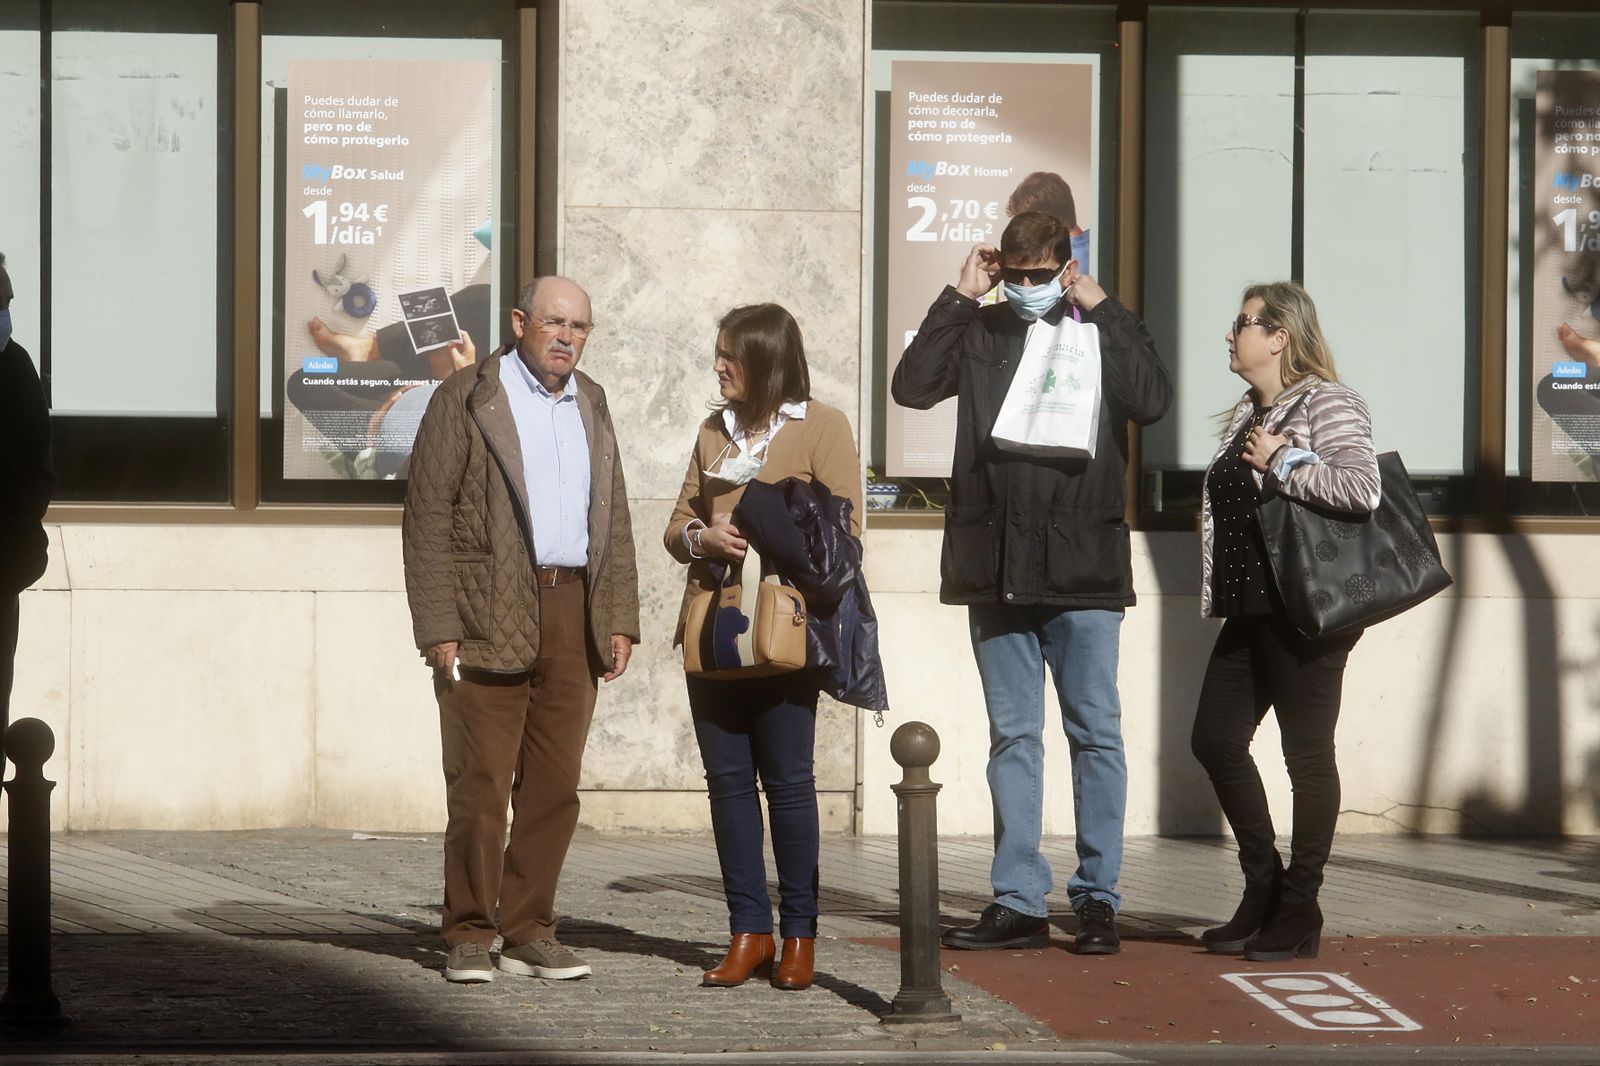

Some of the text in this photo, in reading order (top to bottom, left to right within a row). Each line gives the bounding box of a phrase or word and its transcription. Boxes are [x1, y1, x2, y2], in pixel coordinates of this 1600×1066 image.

[303, 95, 399, 107] Puedes dudar de
[908, 92, 1003, 104] Puedes dudar de
[303, 108, 388, 120] cómo llamarlo,
[908, 105, 999, 118] cómo decorarla,
[1555, 105, 1594, 116] Puedes
[303, 122, 372, 134] pero no de
[908, 119, 976, 131] pero no de
[1554, 118, 1585, 129] cómo
[303, 134, 409, 148] cómo protegerlo
[908, 132, 1012, 145] cómo protegerla
[1554, 132, 1583, 144] pero
[1554, 144, 1588, 154] cómo
[302, 163, 404, 184] MyBox Salud
[905, 160, 972, 180] MyBox
[303, 186, 333, 196] desde
[907, 183, 936, 193] desde
[1554, 194, 1582, 204] desde
[302, 377, 335, 386] Cuando
[336, 378, 359, 386] estás
[360, 378, 391, 387] seguro,
[393, 378, 430, 386] duermes
[1552, 382, 1584, 390] Cuando
